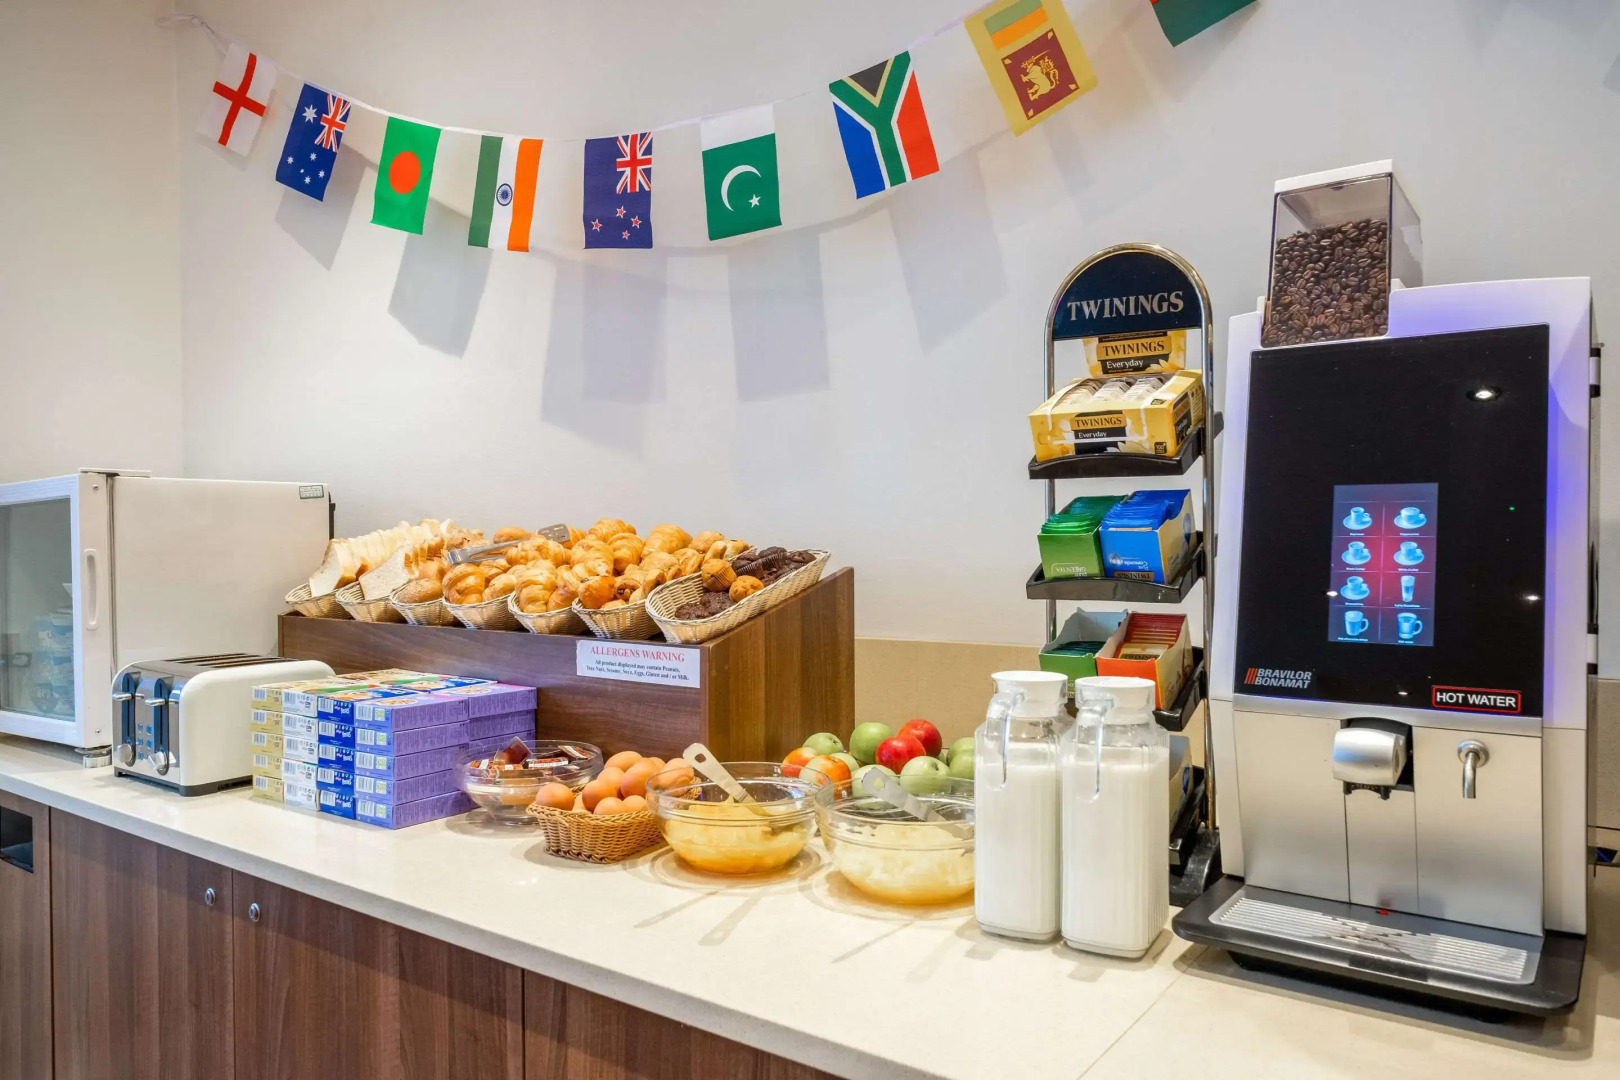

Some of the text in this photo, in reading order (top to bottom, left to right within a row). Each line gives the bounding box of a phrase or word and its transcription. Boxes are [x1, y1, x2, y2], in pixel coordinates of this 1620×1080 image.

[1067, 291, 1184, 321] TWININGS
[1103, 340, 1165, 357] TWININGS
[1106, 359, 1144, 369] Everyday
[1075, 416, 1122, 428] TWININGS
[1078, 431, 1107, 439] Everyday
[590, 646, 685, 662] ALLERGENS WARNING
[1257, 668, 1312, 680] BRAVILOR
[1255, 677, 1311, 688] BONAMAT
[1436, 692, 1516, 708] HOT WATER
